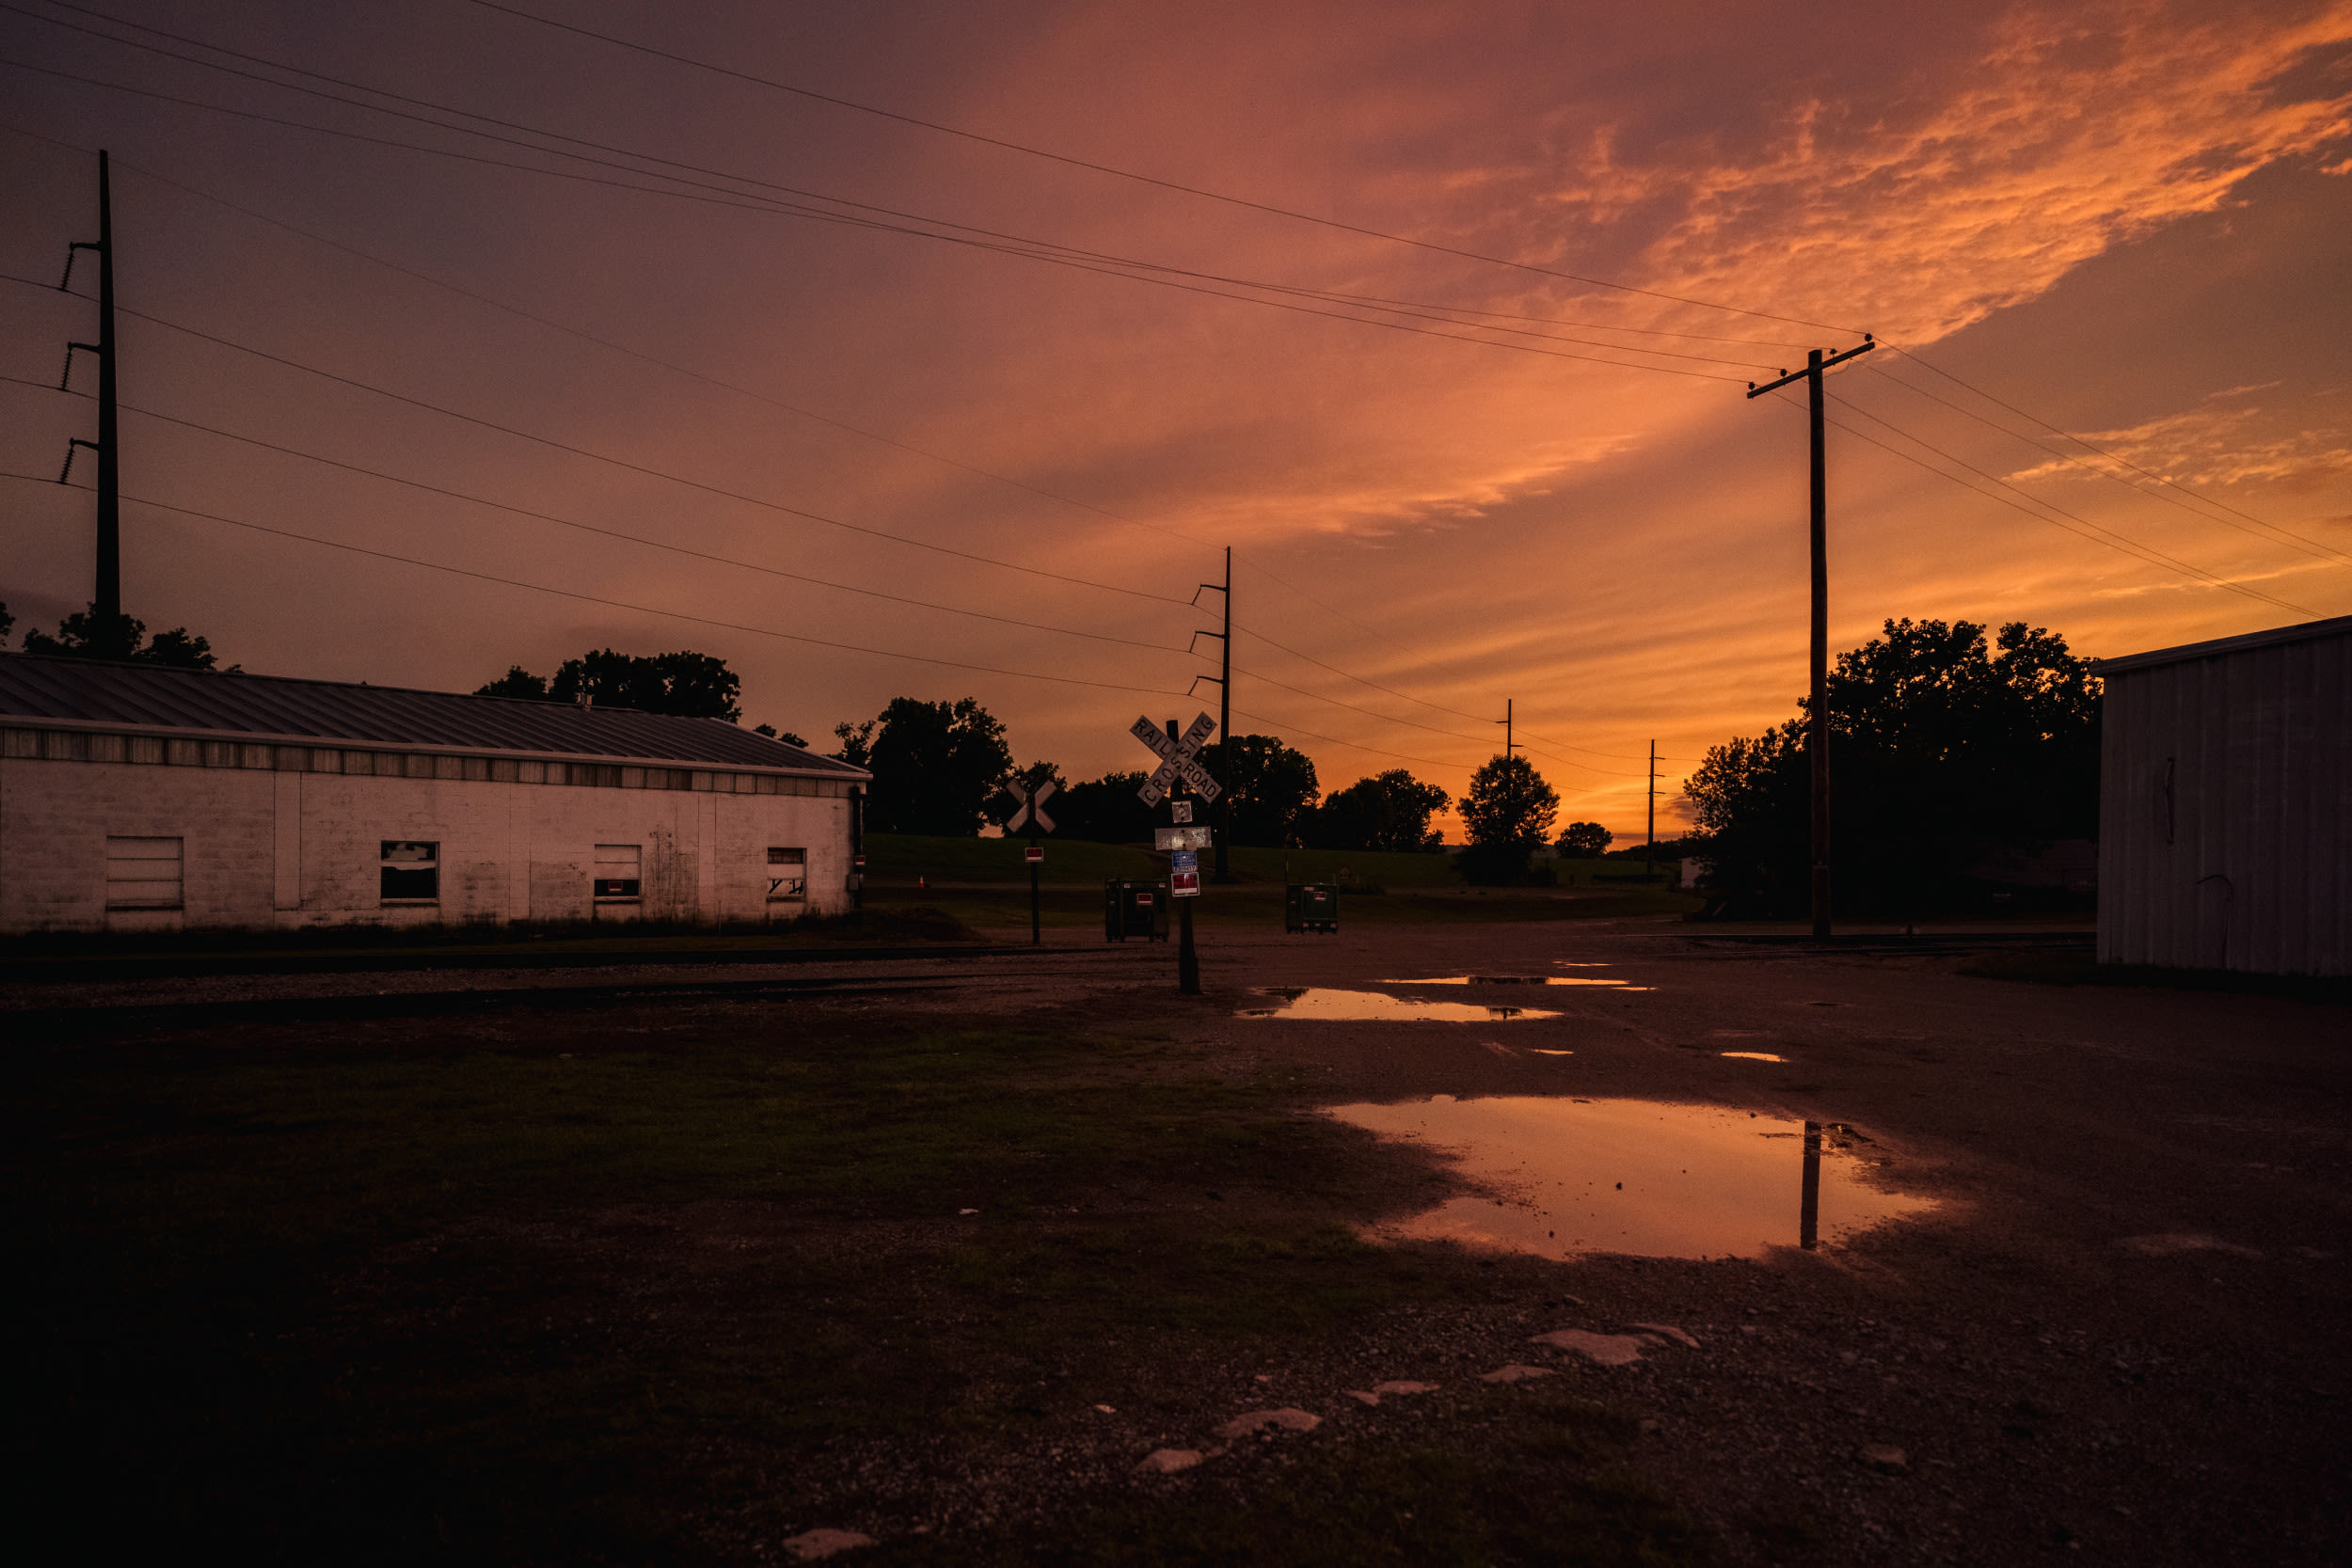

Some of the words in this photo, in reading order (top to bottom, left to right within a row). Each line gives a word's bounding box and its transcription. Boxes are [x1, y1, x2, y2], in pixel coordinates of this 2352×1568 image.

[1135, 720, 1168, 756] RAIL
[1183, 763, 1216, 798] ROAD
[1144, 720, 1213, 801] CROSSING
